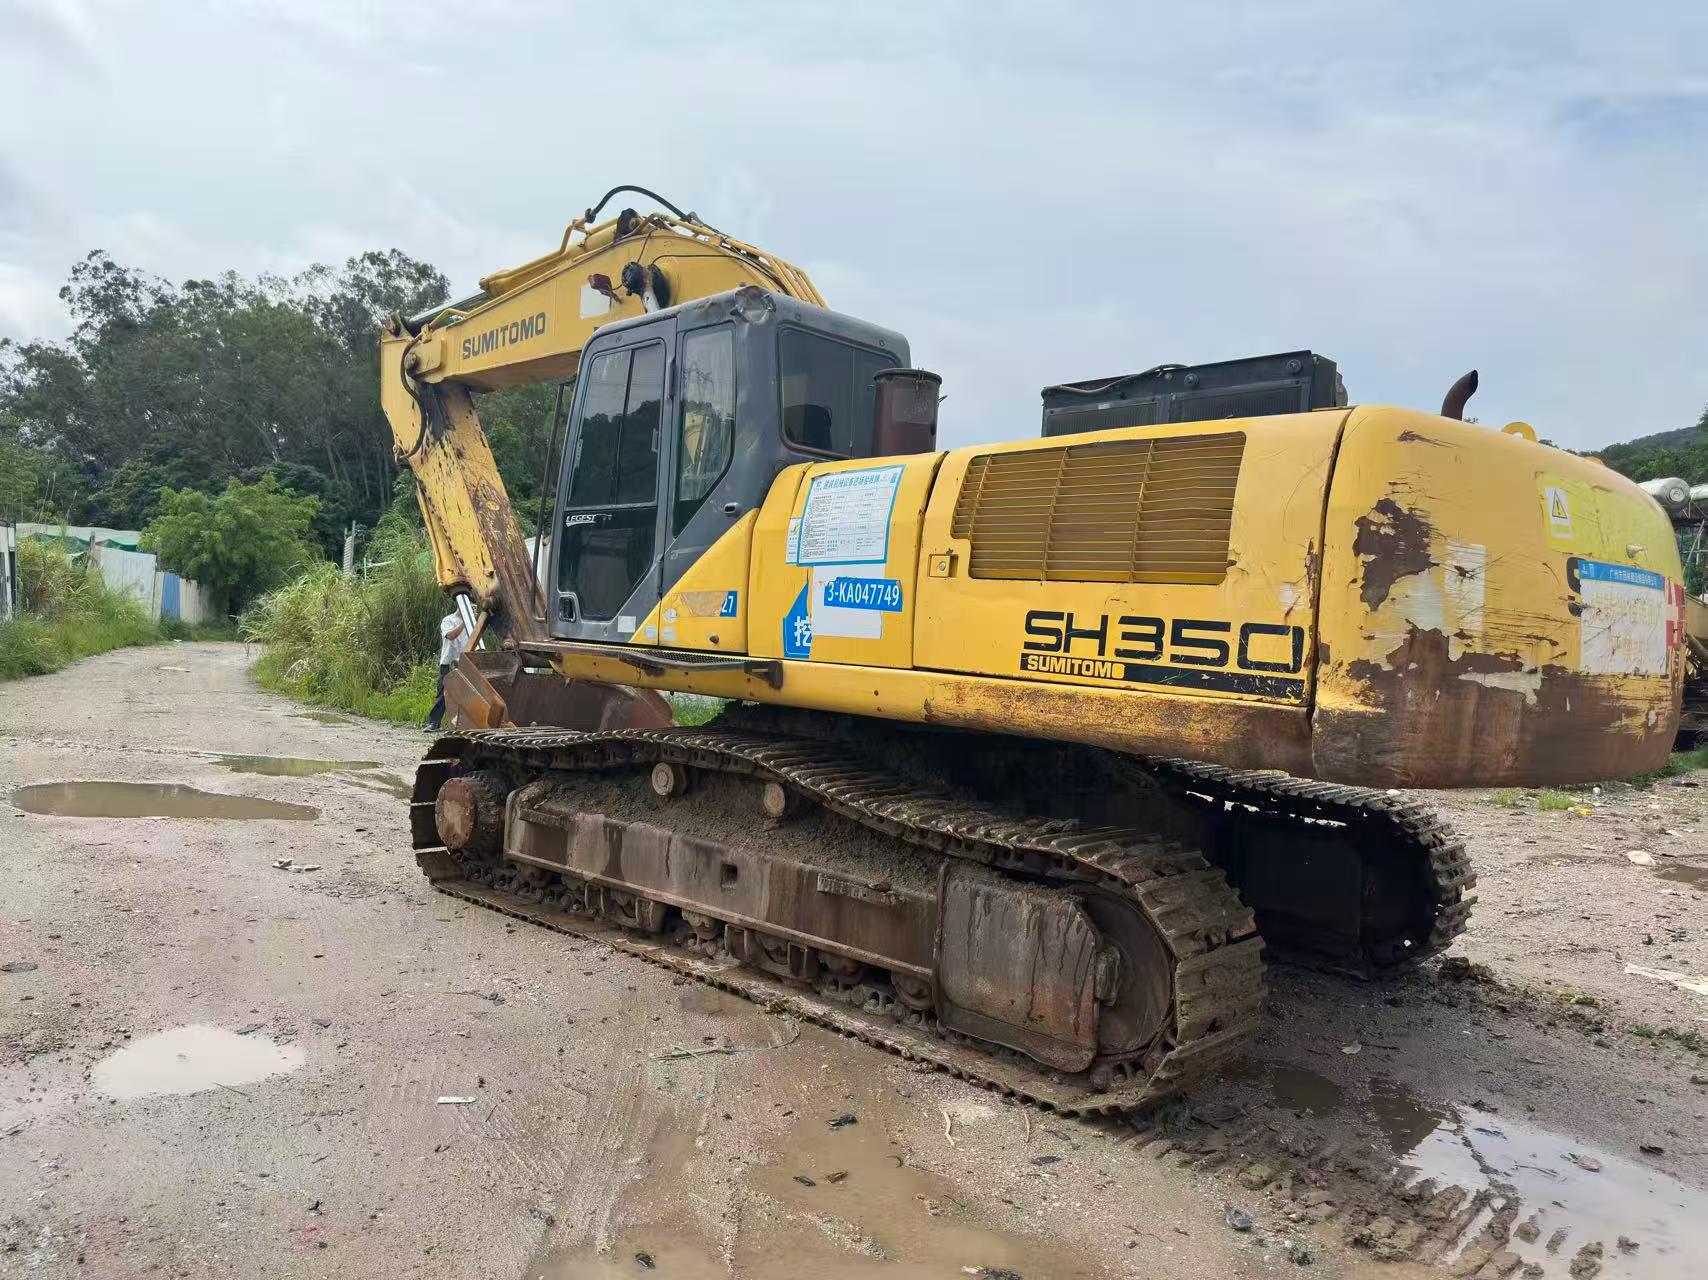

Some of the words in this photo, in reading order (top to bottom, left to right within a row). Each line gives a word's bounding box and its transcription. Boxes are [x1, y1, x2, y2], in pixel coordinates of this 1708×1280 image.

[463, 312, 545, 359] SUMITOMO
[827, 582, 900, 606] 3-KA047749
[1023, 609, 1305, 674] SH350
